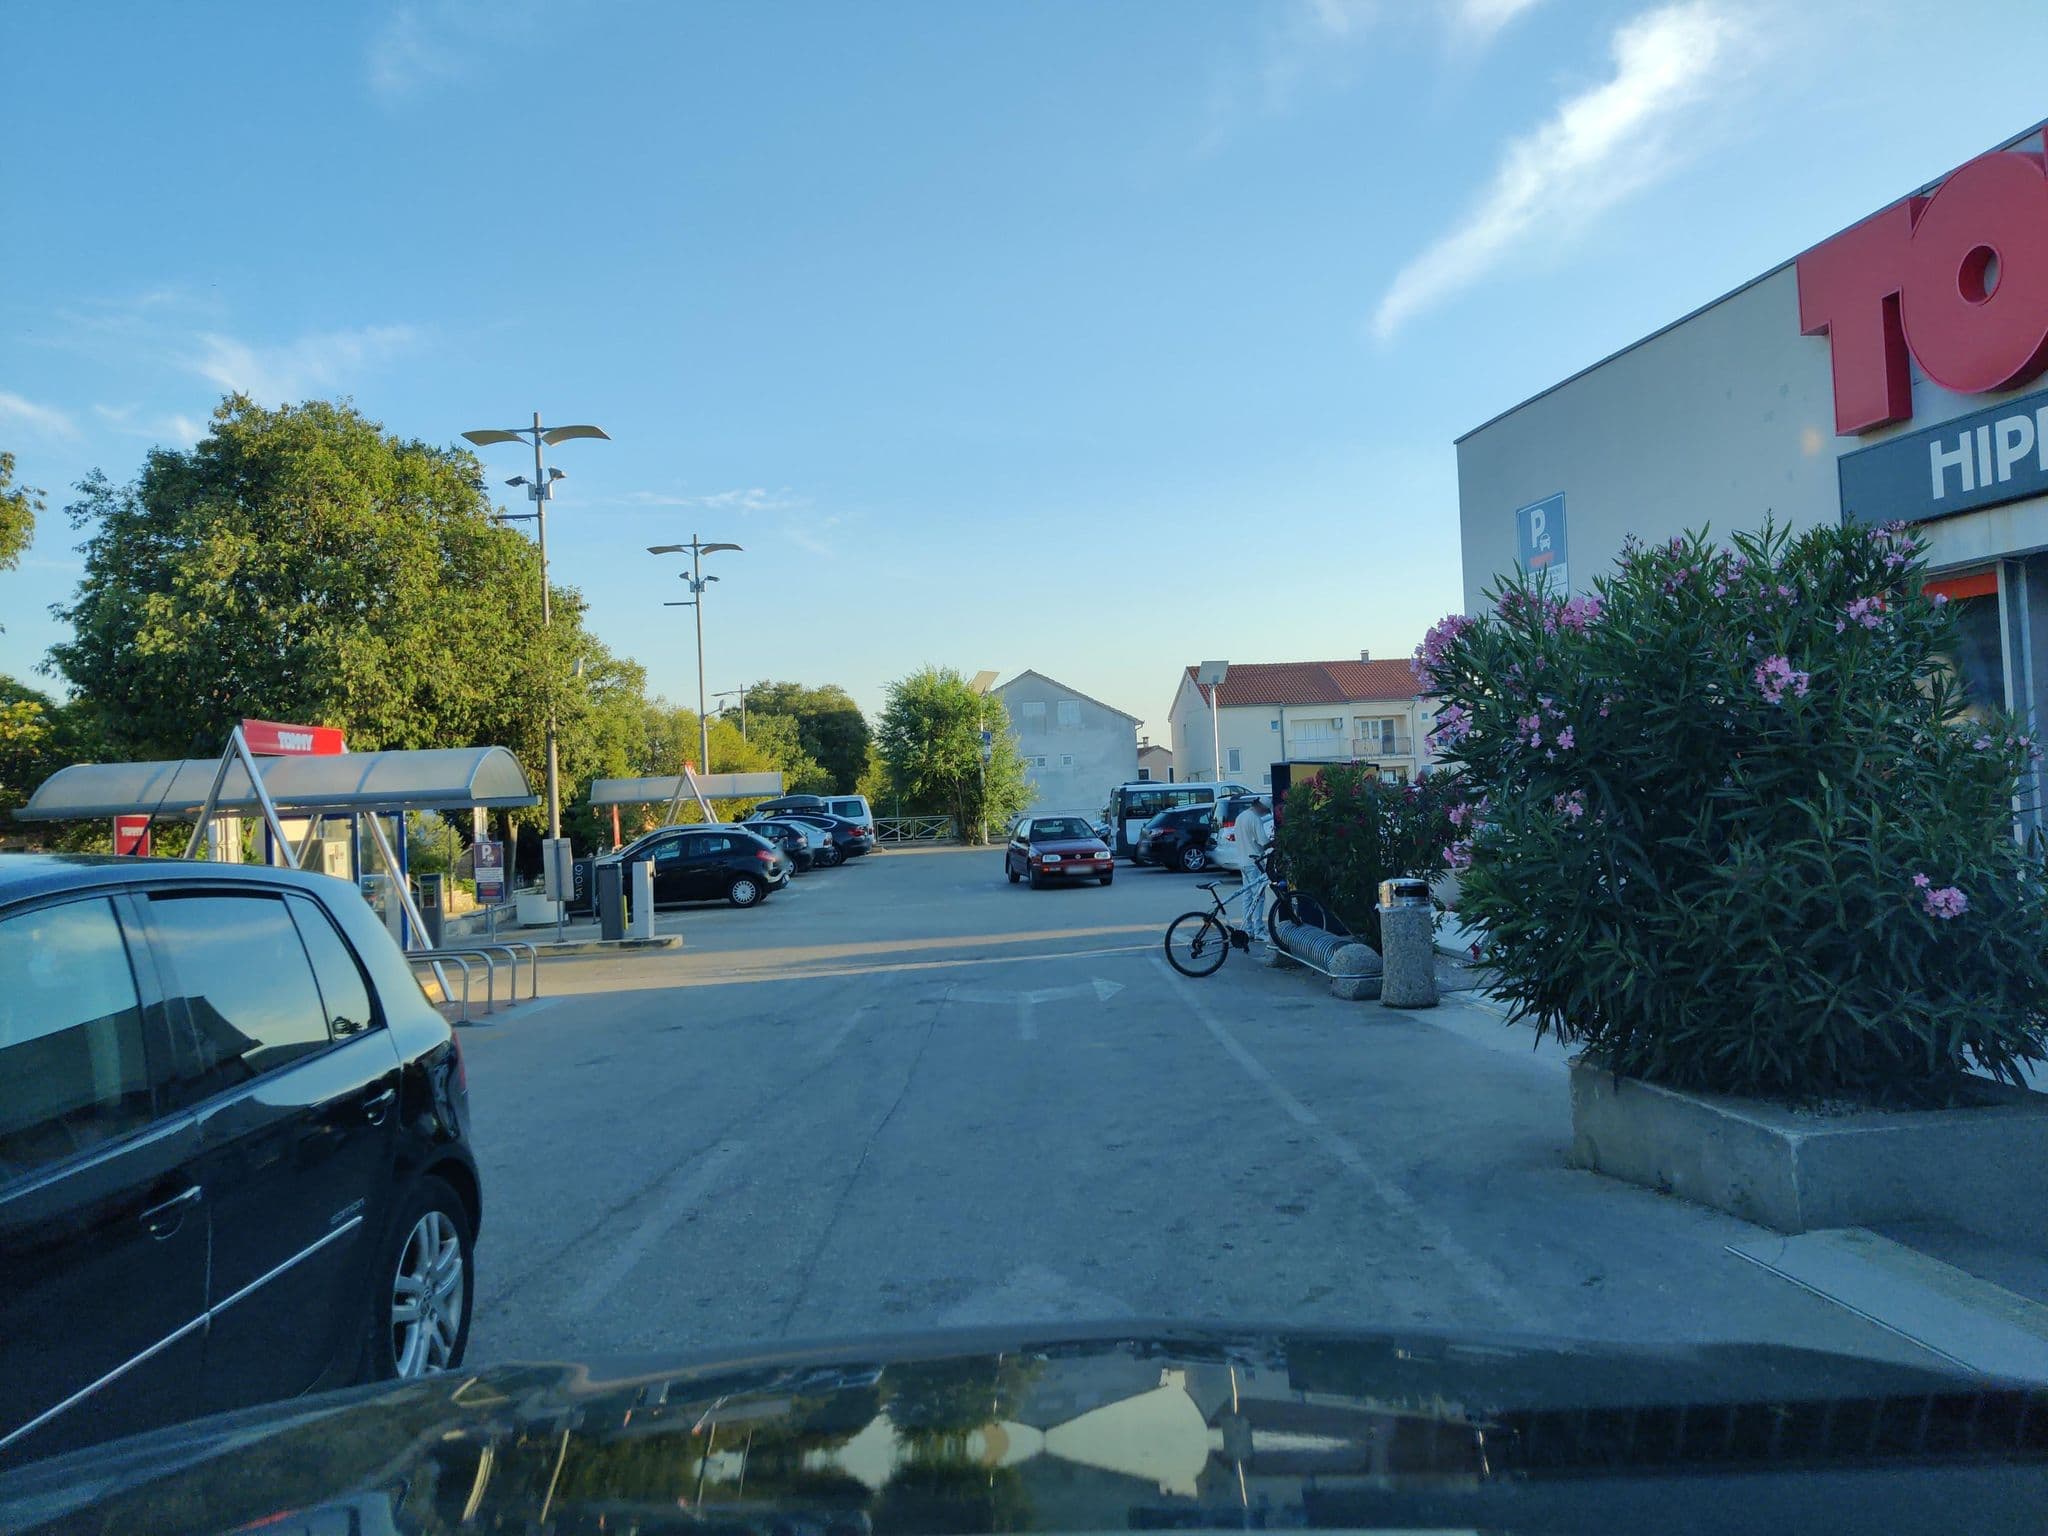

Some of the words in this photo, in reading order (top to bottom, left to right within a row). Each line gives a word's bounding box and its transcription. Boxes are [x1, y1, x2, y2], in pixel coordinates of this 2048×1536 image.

[1796, 148, 2048, 437] TO
[1930, 405, 2048, 500] HIP
[1530, 508, 1546, 548] P
[277, 731, 314, 751] TOMMY
